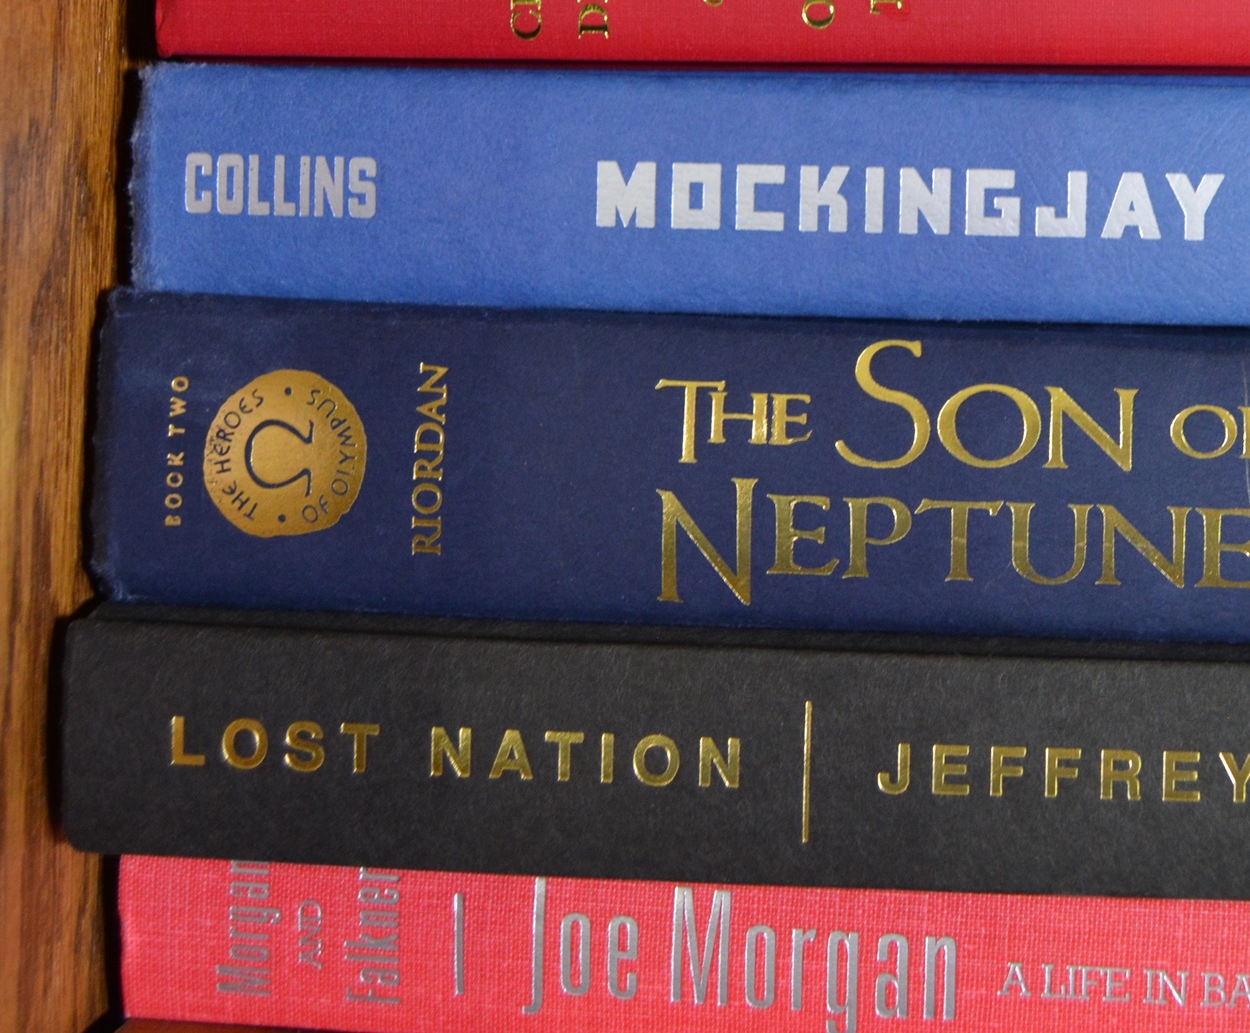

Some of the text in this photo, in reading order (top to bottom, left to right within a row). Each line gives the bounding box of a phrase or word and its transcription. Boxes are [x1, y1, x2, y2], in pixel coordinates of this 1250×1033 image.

[184, 151, 378, 220] COLLINS
[595, 160, 1226, 241] MOCKINGJAY
[164, 375, 190, 528] BOOK TWO
[212, 387, 265, 521] THE HEROES
[301, 388, 359, 524] OF OLYMPUS
[411, 361, 450, 557] RIORDAN
[655, 378, 813, 464] THE
[834, 339, 1140, 472] SON
[169, 714, 740, 789] LOST NATION
[215, 859, 283, 997] Morgan
[297, 899, 323, 970] AND
[343, 866, 401, 1005] Falkner
[521, 876, 958, 1033] Joe Morgan
[997, 962, 1032, 997] A
[1040, 964, 1131, 1004] LIFE
[1142, 968, 1188, 1008] IN
